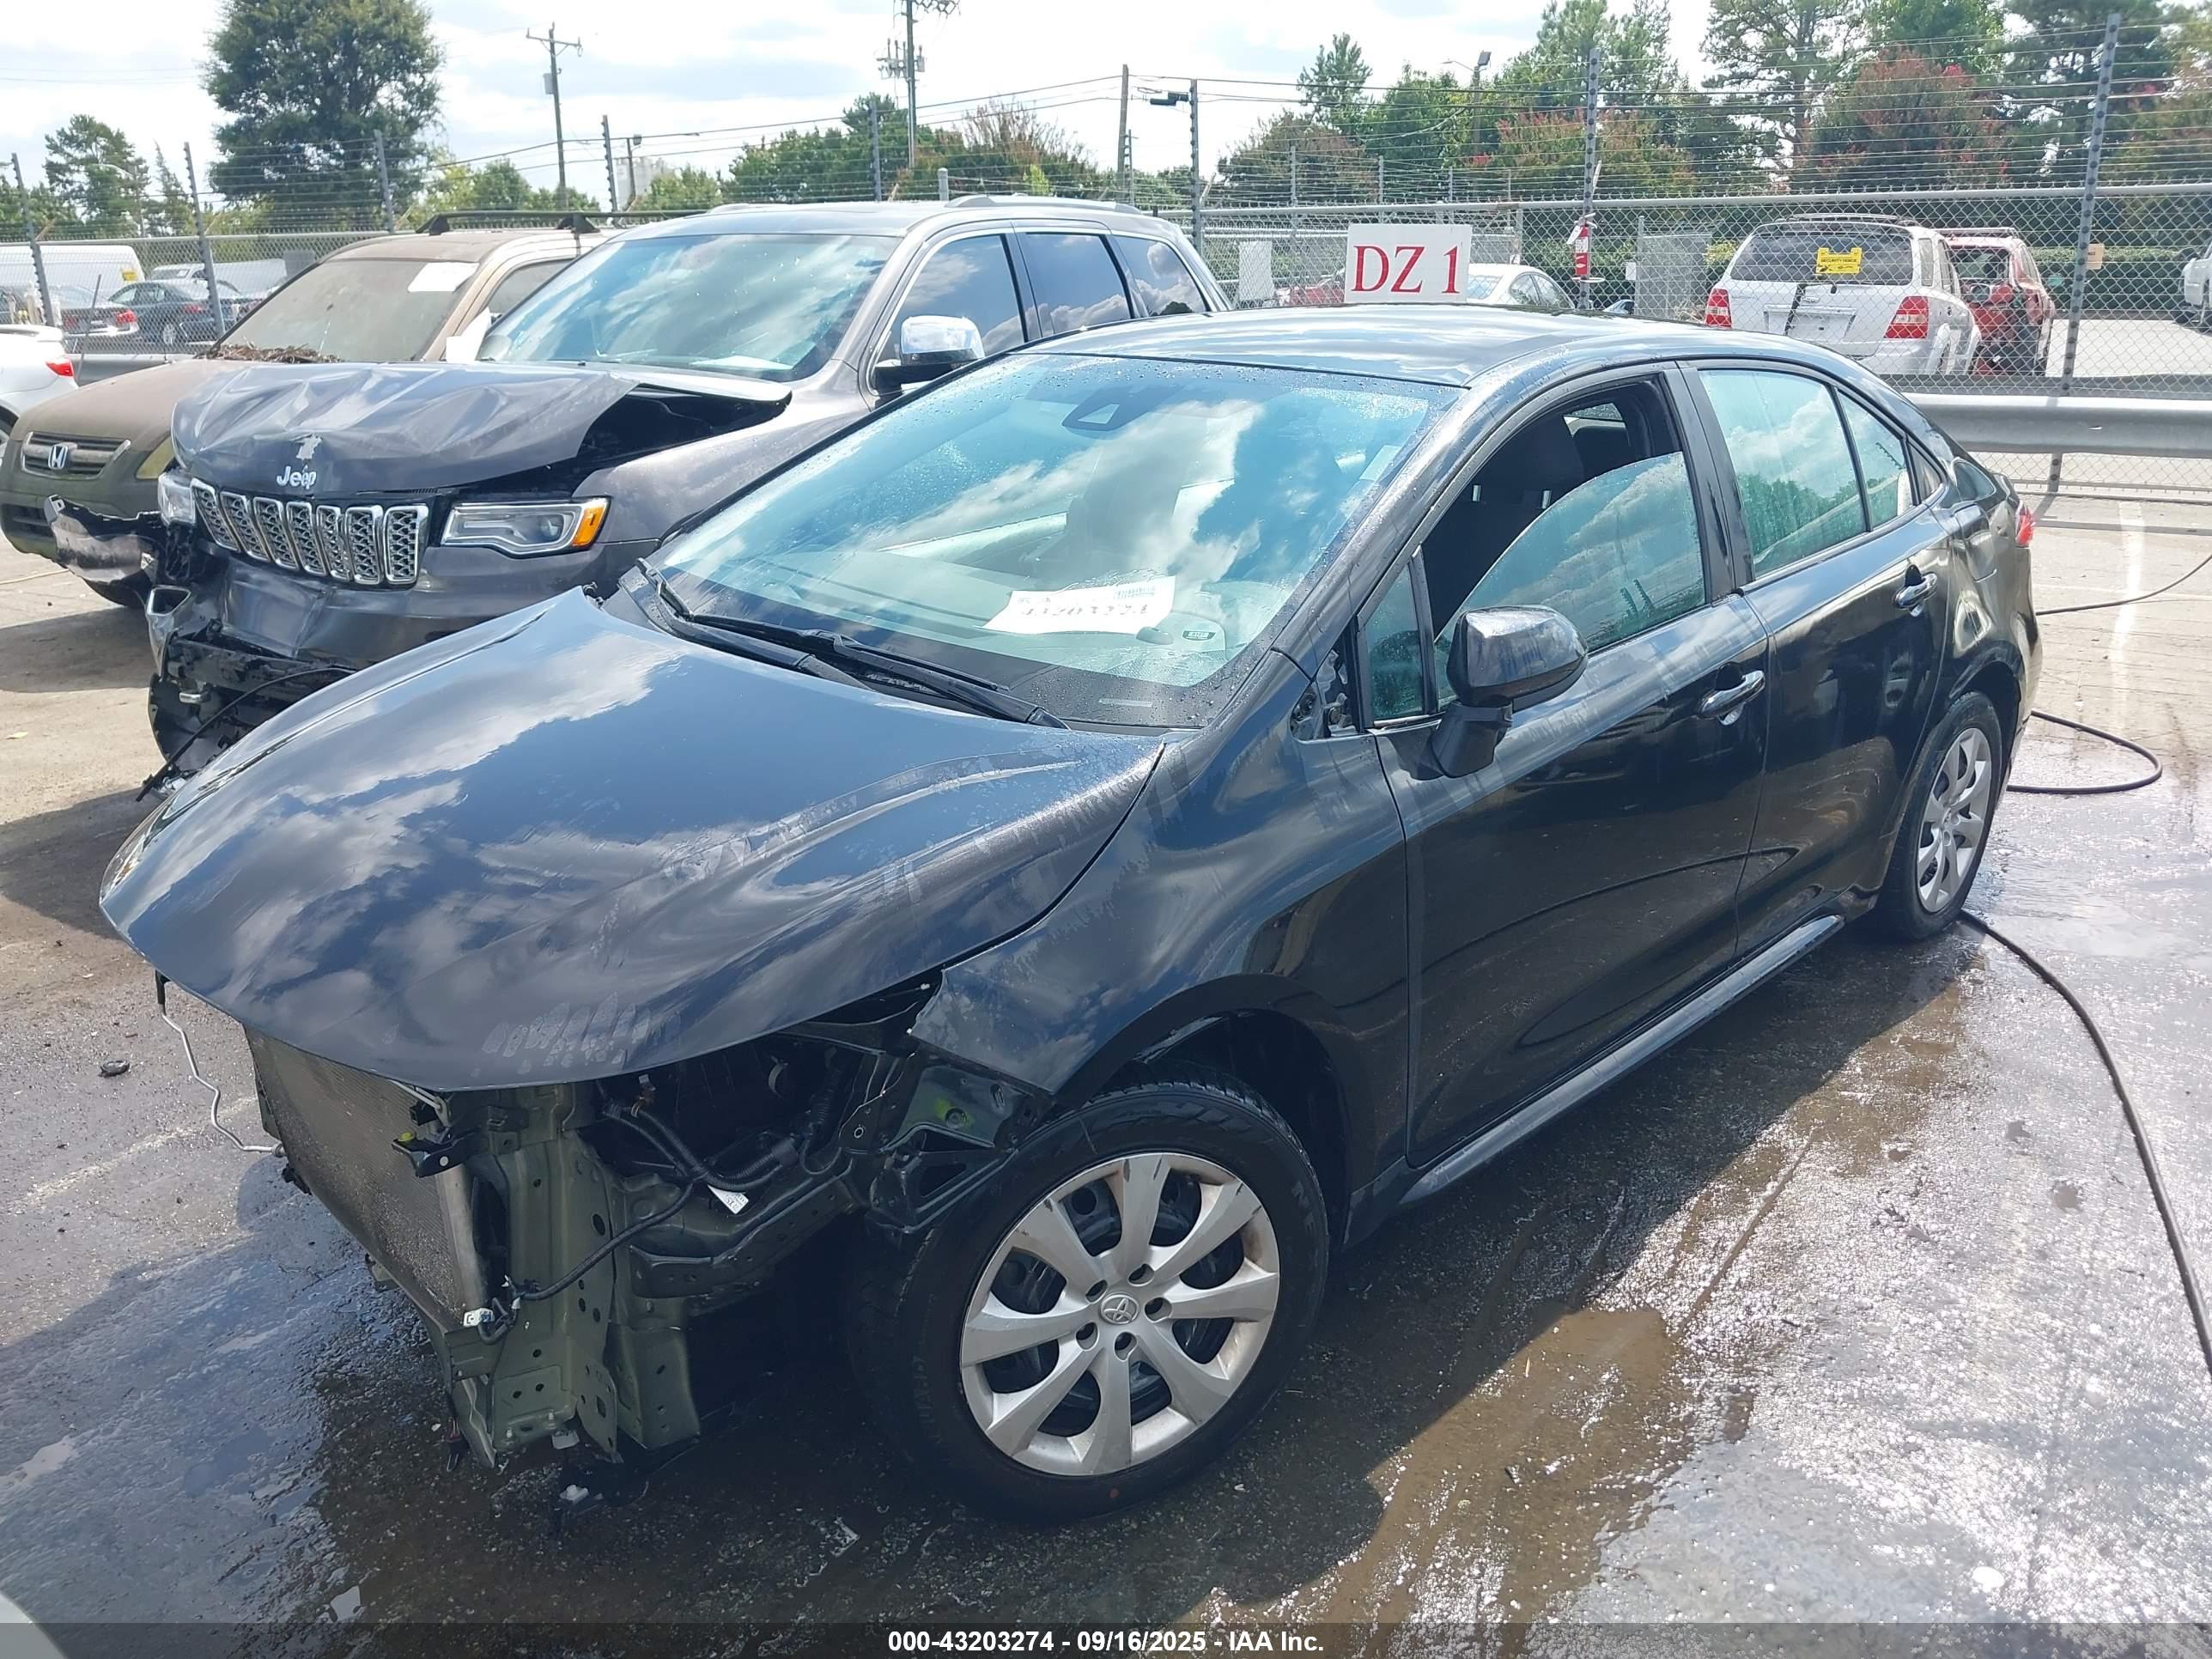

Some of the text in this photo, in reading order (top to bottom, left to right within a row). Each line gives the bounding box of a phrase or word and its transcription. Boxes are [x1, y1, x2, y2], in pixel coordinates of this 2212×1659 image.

[1351, 245, 1461, 294] DZ 1
[276, 465, 317, 489] Jeep
